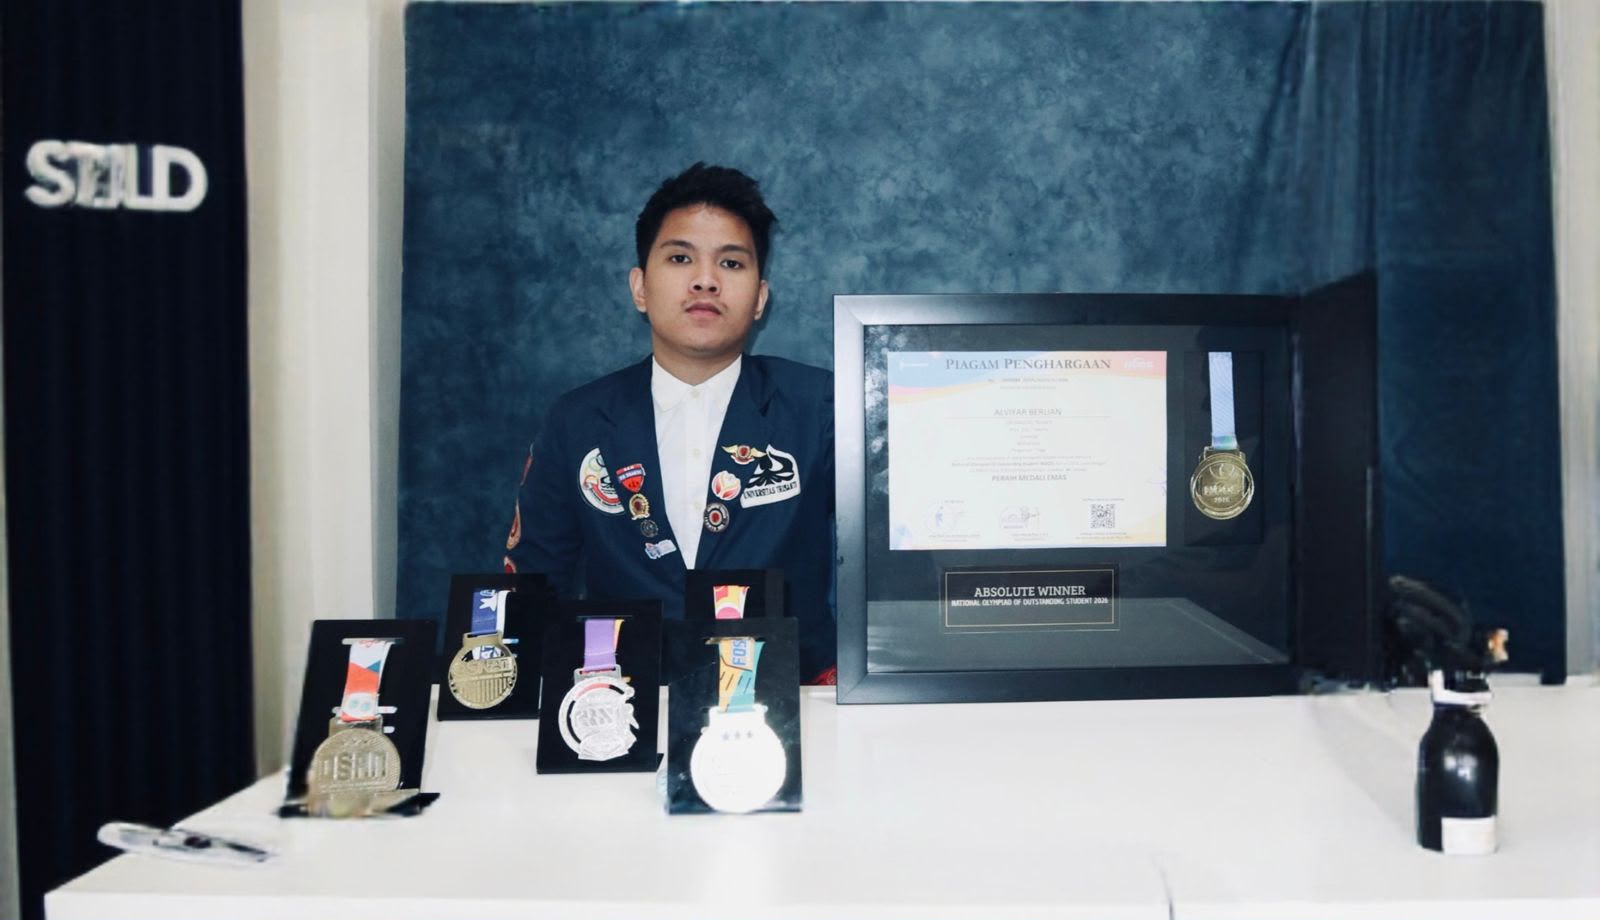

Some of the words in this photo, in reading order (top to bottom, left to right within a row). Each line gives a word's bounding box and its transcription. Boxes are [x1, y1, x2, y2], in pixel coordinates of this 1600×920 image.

[945, 359, 999, 370] PIAGAM
[1003, 358, 1112, 370] PENGHARGAAN
[974, 586, 1035, 598] ABSOLUTE
[1038, 585, 1087, 596] WINNER
[951, 599, 980, 607] NATIONAL
[981, 598, 1012, 607] OLYMPIAD
[1013, 598, 1021, 606] OF
[1022, 598, 1064, 606] OUTSTANDING
[1065, 597, 1092, 605] STUDENT
